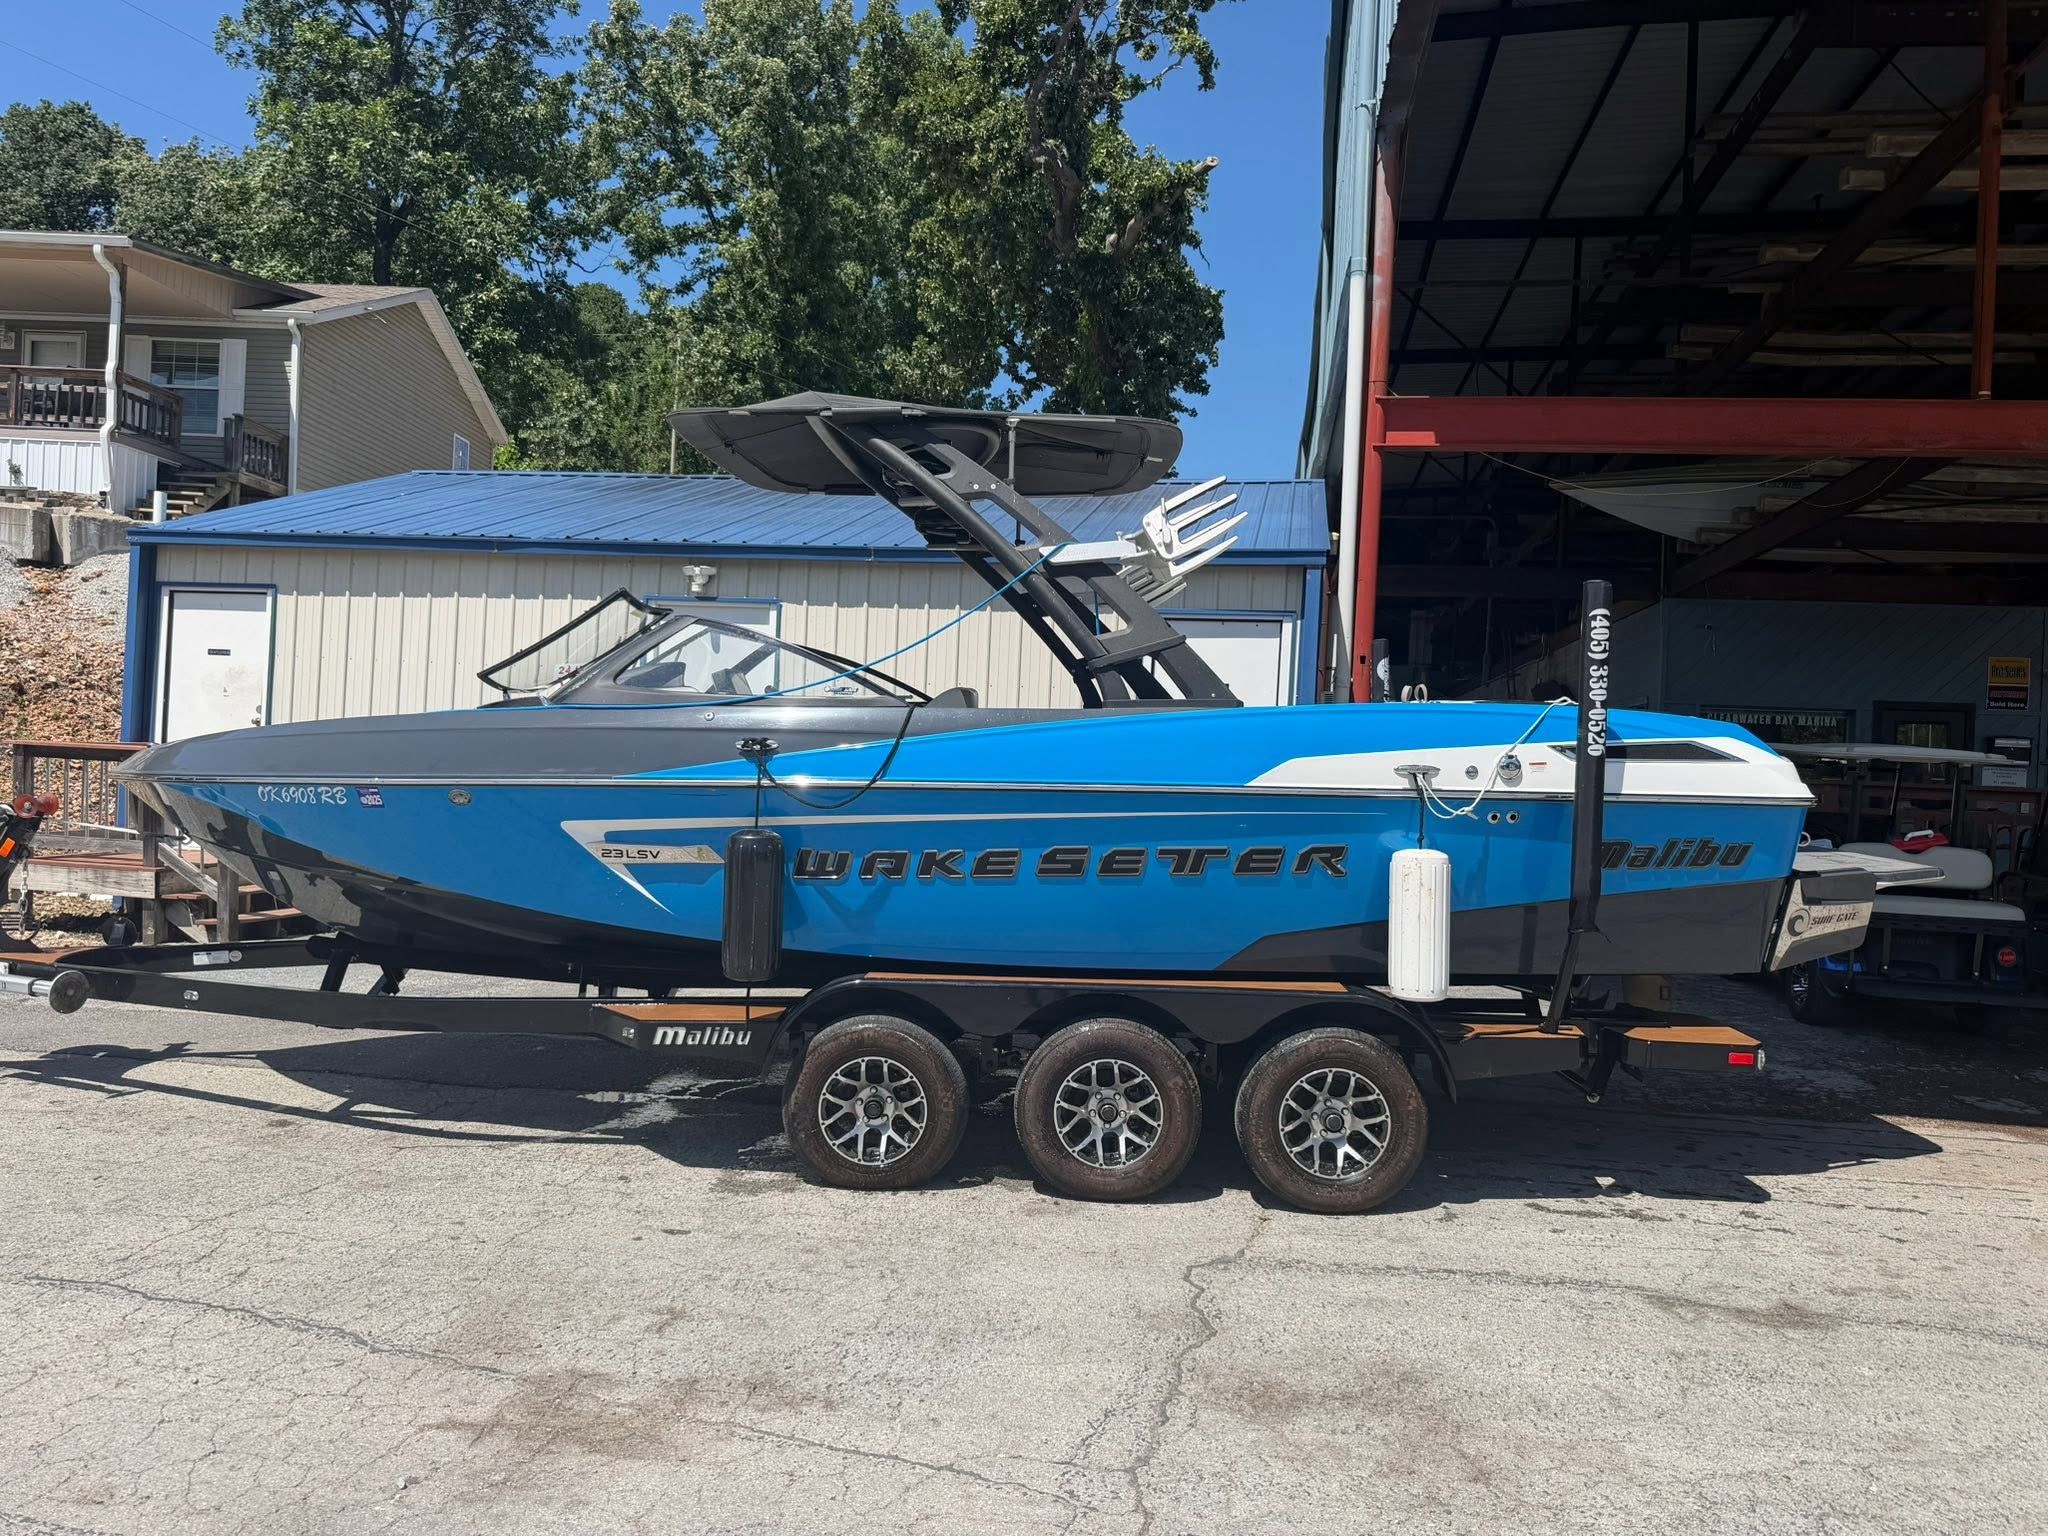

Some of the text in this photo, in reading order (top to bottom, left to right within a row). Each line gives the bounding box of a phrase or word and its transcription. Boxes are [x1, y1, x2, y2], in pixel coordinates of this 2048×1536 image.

[1587, 608, 1611, 757] (405) 330-0526
[1775, 714, 1795, 726] BAY
[1798, 715, 1838, 728] MARINA
[1811, 911, 1860, 925] SURF GATE
[652, 1026, 752, 1046] Malibu
